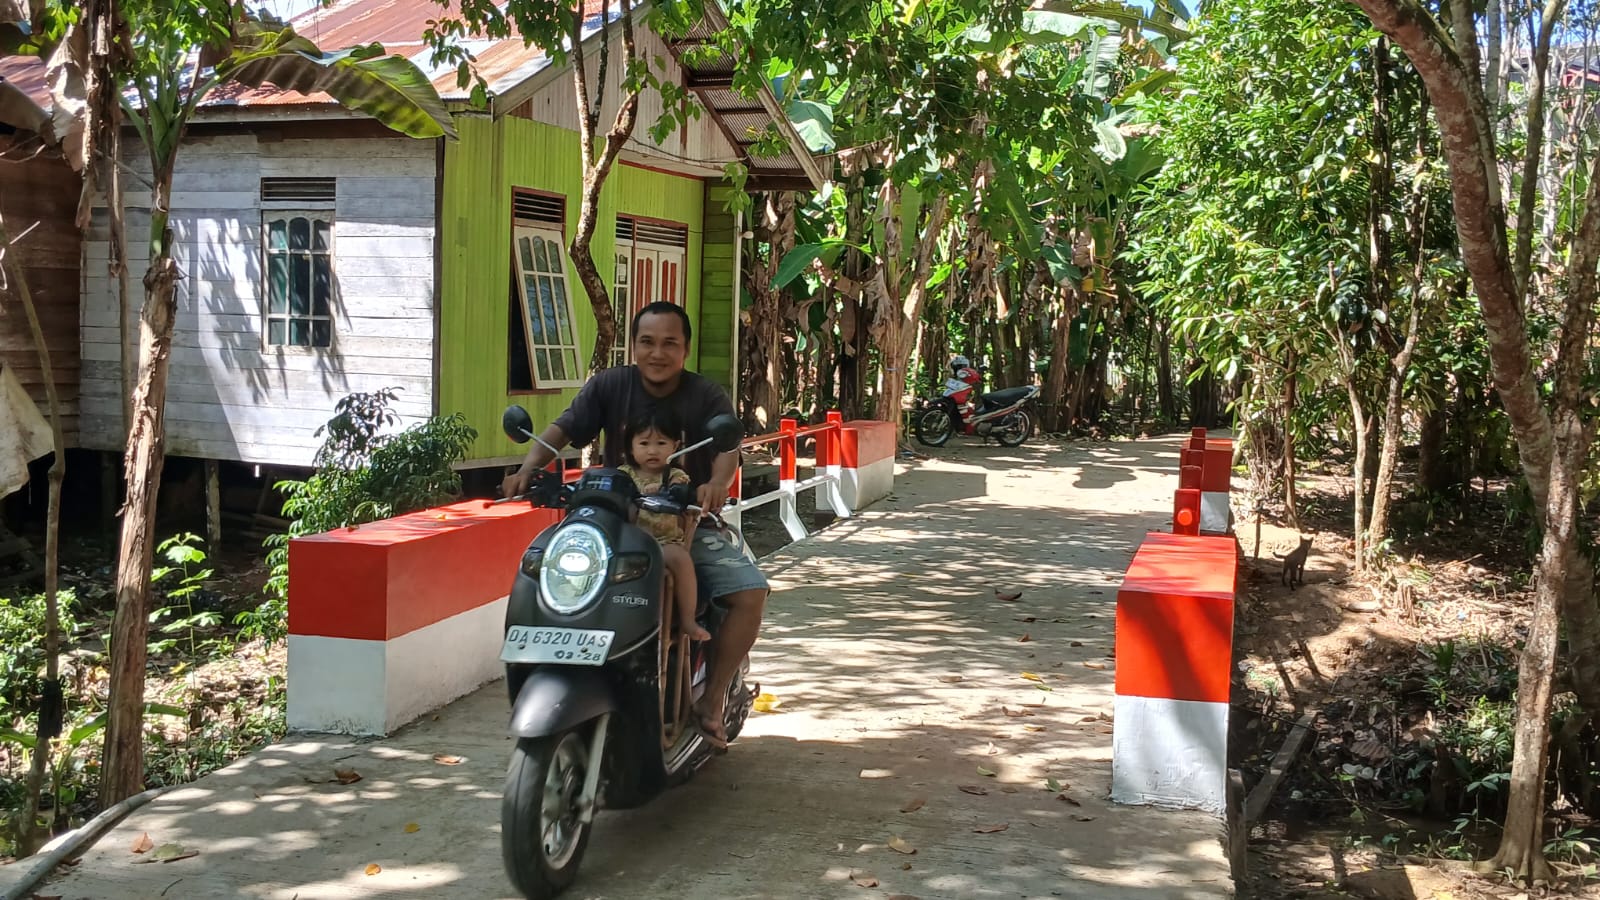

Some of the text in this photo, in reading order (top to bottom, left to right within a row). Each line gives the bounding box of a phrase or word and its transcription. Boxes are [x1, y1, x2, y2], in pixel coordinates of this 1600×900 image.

[612, 595, 649, 606] STYLISH
[508, 629, 608, 647] DA 6320 UAS
